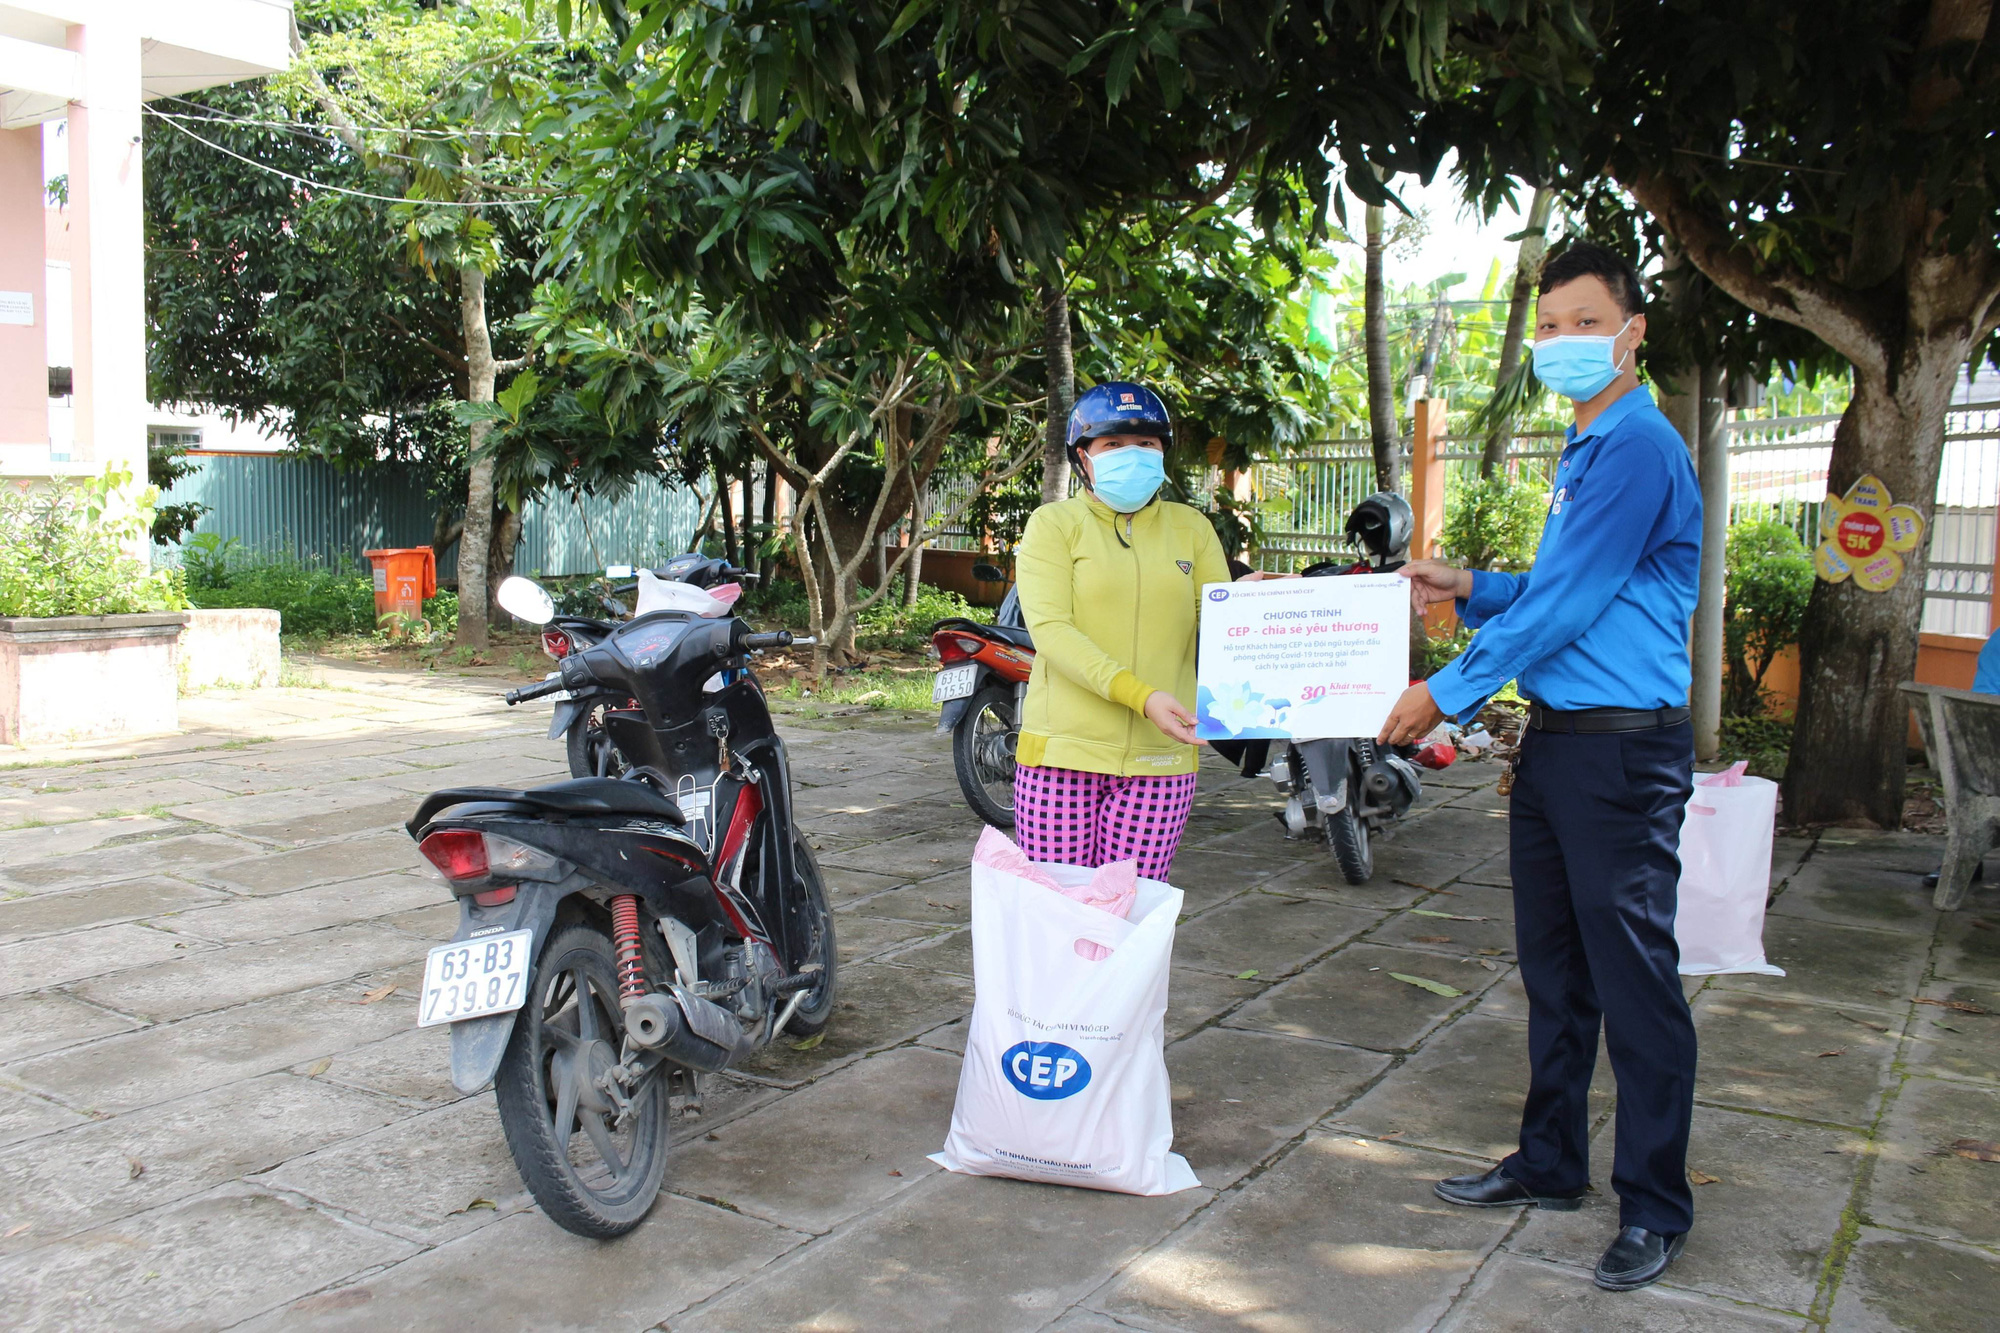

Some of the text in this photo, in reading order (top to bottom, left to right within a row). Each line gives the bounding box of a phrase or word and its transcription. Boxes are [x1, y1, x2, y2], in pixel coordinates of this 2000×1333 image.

[1846, 534, 1872, 550] 5K
[1211, 591, 1227, 600] CEP
[1264, 608, 1342, 620] CHƯƠNG TRÌNH
[1228, 626, 1250, 637] CEP
[1262, 625, 1286, 635] chia
[1290, 624, 1302, 634] sẻ
[1306, 623, 1327, 636] yêu
[1332, 622, 1378, 633] thương
[1234, 654, 1256, 662] phòng
[1257, 652, 1279, 660] chống
[941, 668, 970, 686] 63-C1
[936, 682, 972, 700] 015.50
[1301, 686, 1326, 700] 30
[470, 926, 505, 938] HONDA
[441, 940, 513, 982] 63-B3
[426, 972, 520, 1020] 739.87
[1033, 1019, 1044, 1030] TÀI
[1080, 1024, 1094, 1032] MÔ
[1012, 1051, 1078, 1088] CEP
[995, 1148, 1008, 1157] CHI
